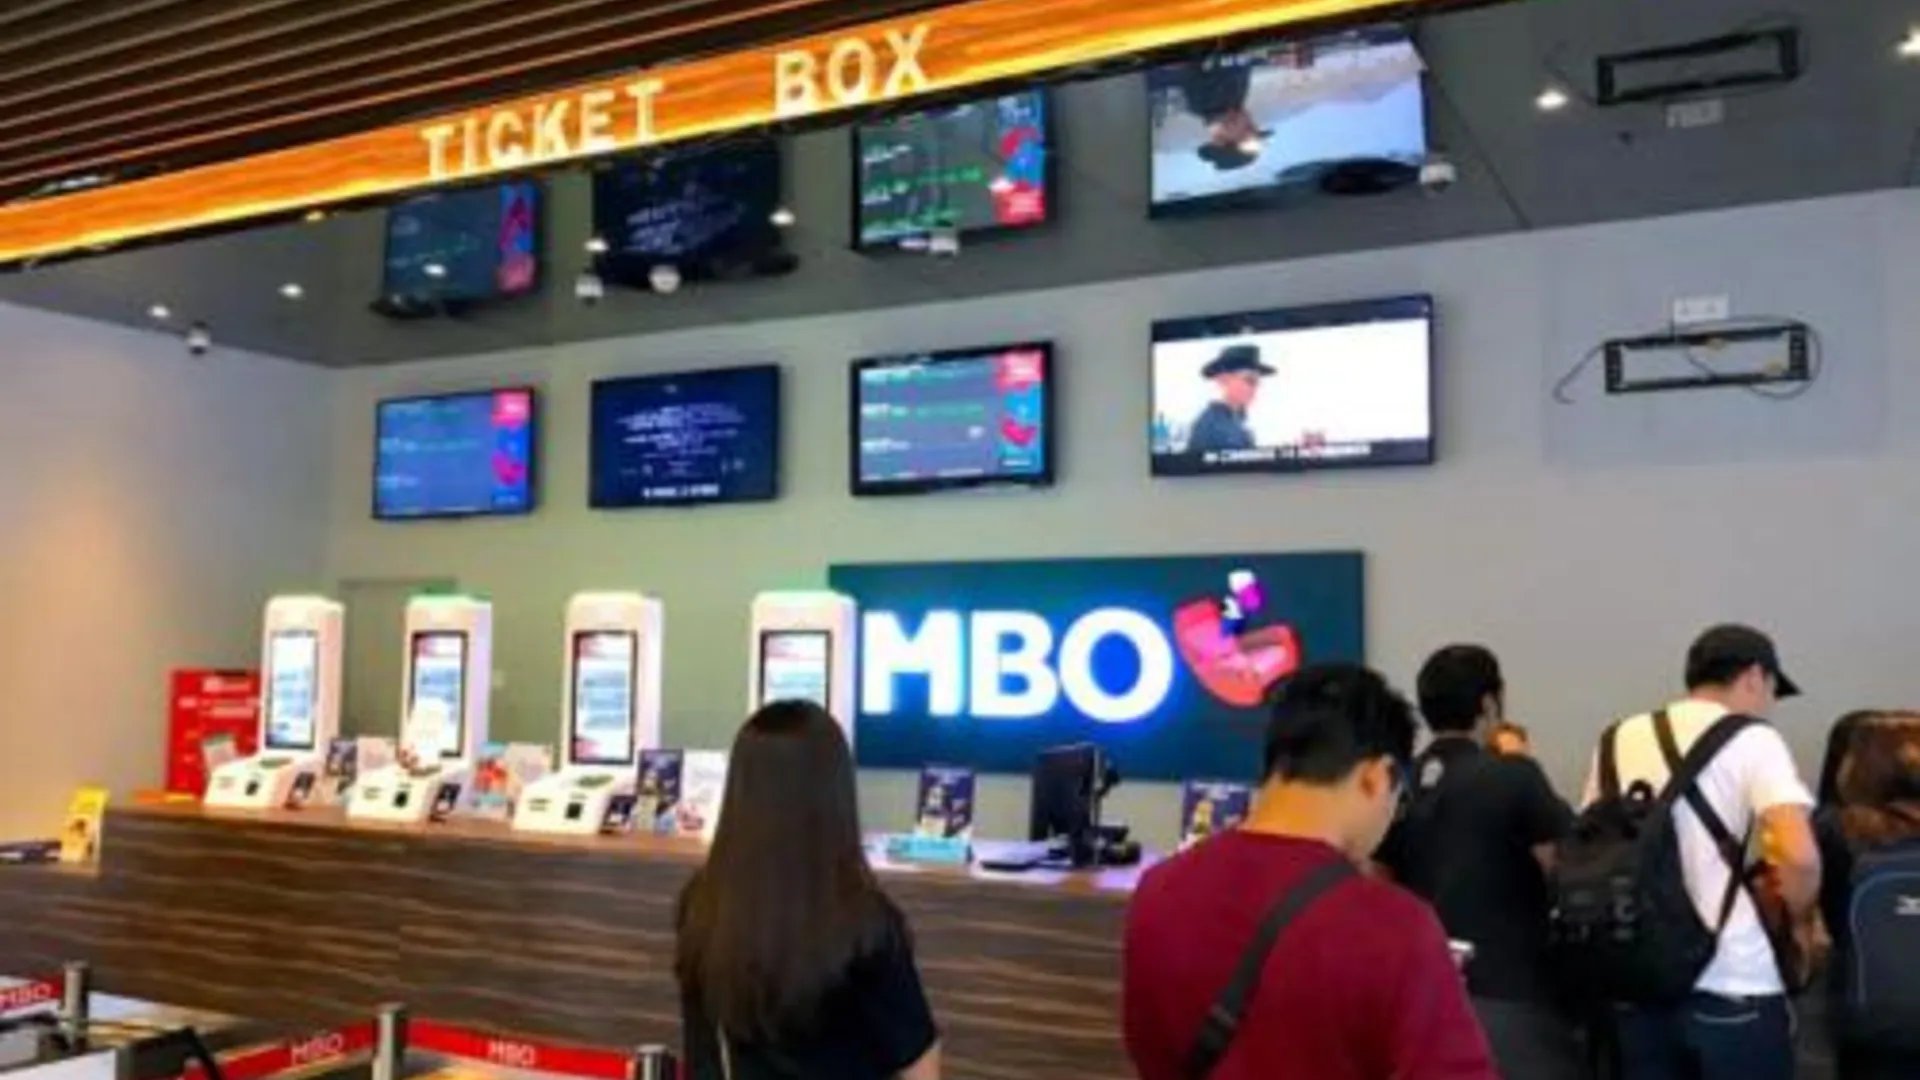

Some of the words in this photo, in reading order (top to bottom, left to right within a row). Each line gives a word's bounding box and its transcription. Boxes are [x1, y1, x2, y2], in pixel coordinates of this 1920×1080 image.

[421, 79, 666, 180] TICKET
[774, 23, 931, 119] BOX
[861, 606, 1174, 723] MBO
[290, 1032, 344, 1067] MBO
[487, 1040, 537, 1068] MBO
